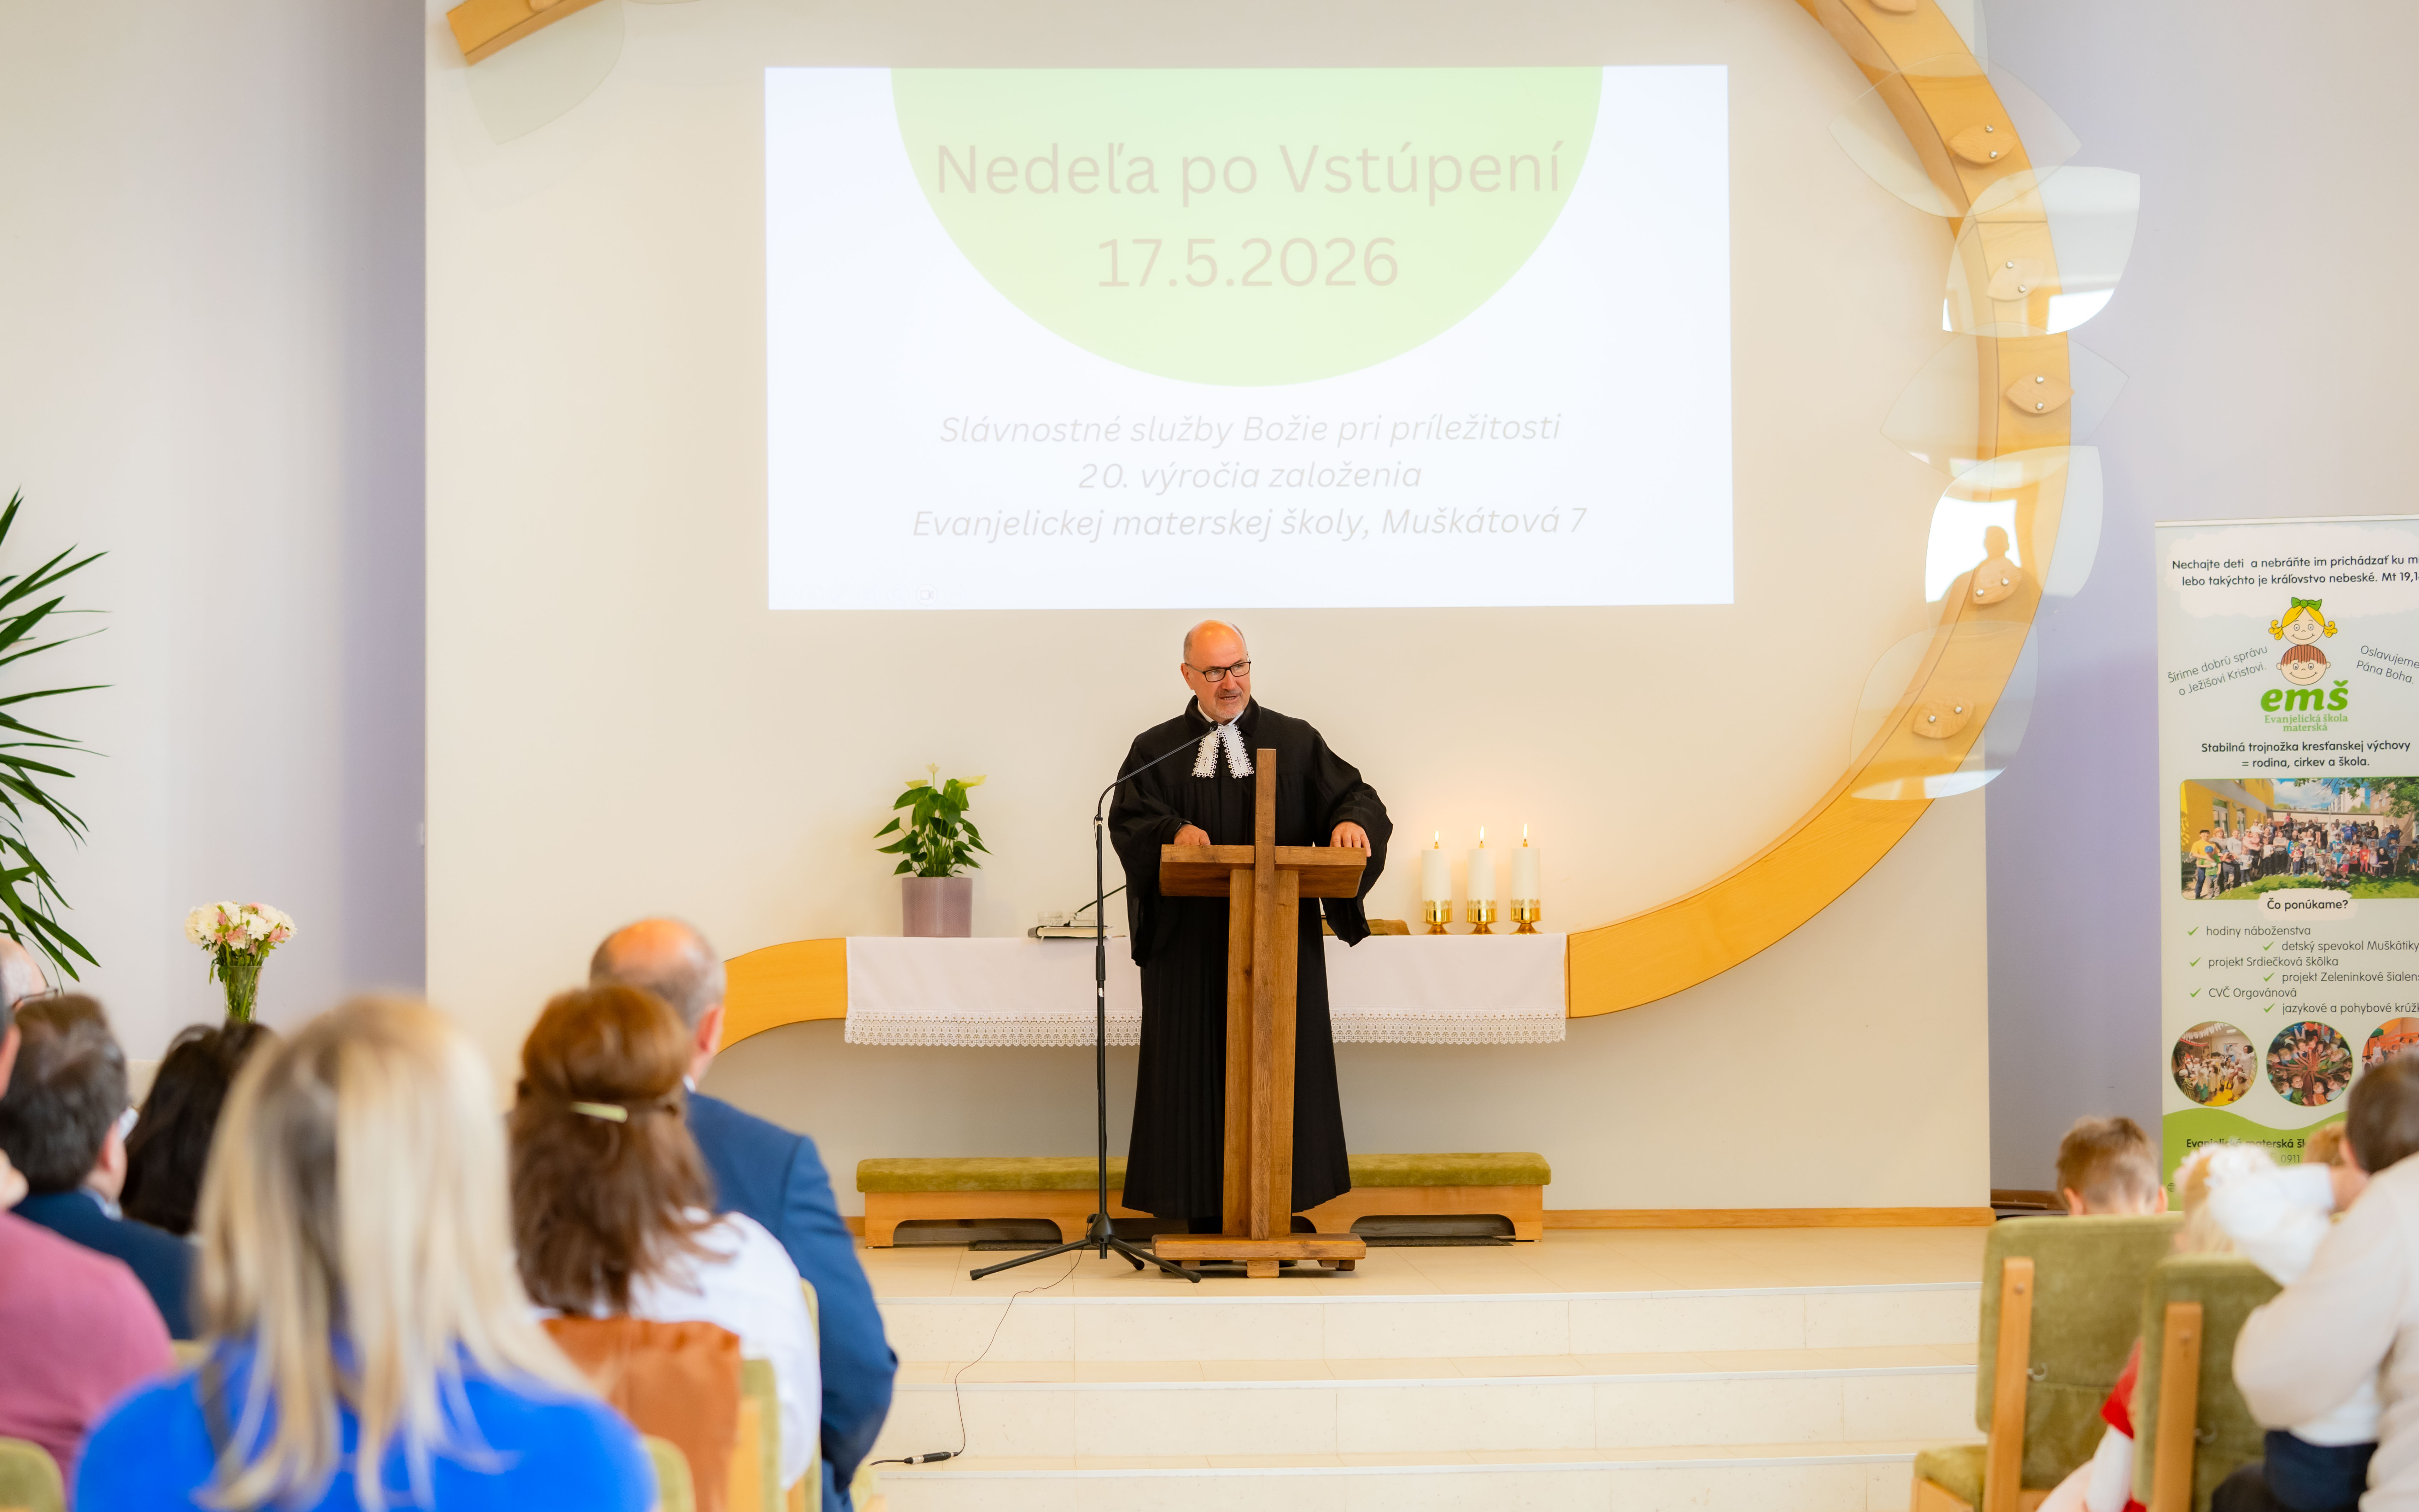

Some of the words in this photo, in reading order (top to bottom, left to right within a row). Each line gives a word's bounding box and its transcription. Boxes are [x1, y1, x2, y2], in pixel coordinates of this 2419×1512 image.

[938, 142, 1160, 195] Nedeľa
[1182, 156, 1258, 208] po
[1278, 140, 1565, 208] Vstúpení
[1098, 237, 1399, 288] 17.5.2026
[939, 415, 1121, 443] Slávnostné
[1130, 414, 1235, 450] služby
[1243, 414, 1328, 442] Božie
[1337, 414, 1382, 448] pri
[1389, 413, 1562, 448] príležitosti
[1078, 463, 1128, 489] 20.
[1141, 461, 1260, 496] výročia
[1267, 460, 1422, 488] založenia
[913, 509, 1105, 544] Evanjelickej
[1112, 508, 1273, 543] materskej
[1281, 507, 1369, 542] školy,
[1382, 505, 1560, 535] Muškátová
[1570, 507, 1588, 533] 7
[2172, 559, 2220, 571] Nechajte
[2223, 558, 2244, 568] deti
[2261, 557, 2310, 568] nebráňte
[2314, 557, 2327, 566] im
[2330, 554, 2389, 568] prichádzať
[2391, 555, 2404, 565] ku
[2182, 576, 2205, 586] lebo
[2209, 575, 2255, 588] takýchto
[2258, 575, 2268, 587] je
[2271, 573, 2326, 584] kráľovstvo
[2329, 572, 2378, 583] nebeské.
[2382, 572, 2397, 582] Mt
[2399, 572, 2419, 583] 19,1
[2167, 667, 2199, 683] Šírime
[2201, 655, 2231, 672] dobrú
[2233, 646, 2268, 663] správu
[2360, 645, 2419, 669] Oslavujeme
[2188, 673, 2226, 693] Ježišovi
[2227, 661, 2267, 681] Kristovi.
[2356, 660, 2383, 675] Pána
[2385, 668, 2414, 684] Boha.
[2260, 679, 2349, 712] emš
[2264, 714, 2321, 725] Evanjelická
[2323, 713, 2348, 722] škola
[2283, 723, 2328, 732] materská
[2201, 742, 2245, 753] Stabilná
[2248, 741, 2299, 754] trojnožka
[2302, 740, 2363, 753] kresťanskej
[2366, 740, 2411, 753] výchovy
[2252, 757, 2290, 769] rodina,
[2293, 757, 2325, 767] cirkev
[2338, 756, 2370, 766] škola.
[2267, 897, 2281, 910] Čo
[2284, 899, 2349, 912] ponúkame?
[2206, 926, 2241, 938] hodiny
[2244, 926, 2311, 936] náboženstva
[2281, 940, 2315, 953] detský
[2318, 940, 2364, 953] spevokol
[2367, 940, 2419, 953] Muškátiky
[2208, 956, 2244, 969] projekt
[2246, 956, 2303, 967] Srdiečková
[2305, 956, 2338, 967] škôlka
[2282, 971, 2318, 984] projekt
[2320, 971, 2384, 982] Zeleninkové
[2386, 971, 2419, 982] šialen
[2209, 986, 2230, 998] CVČ
[2233, 987, 2297, 1000] Orgovánová
[2282, 1003, 2327, 1016] jazykové
[2340, 1002, 2392, 1015] pohybové
[2281, 1154, 2300, 1163] 0911
